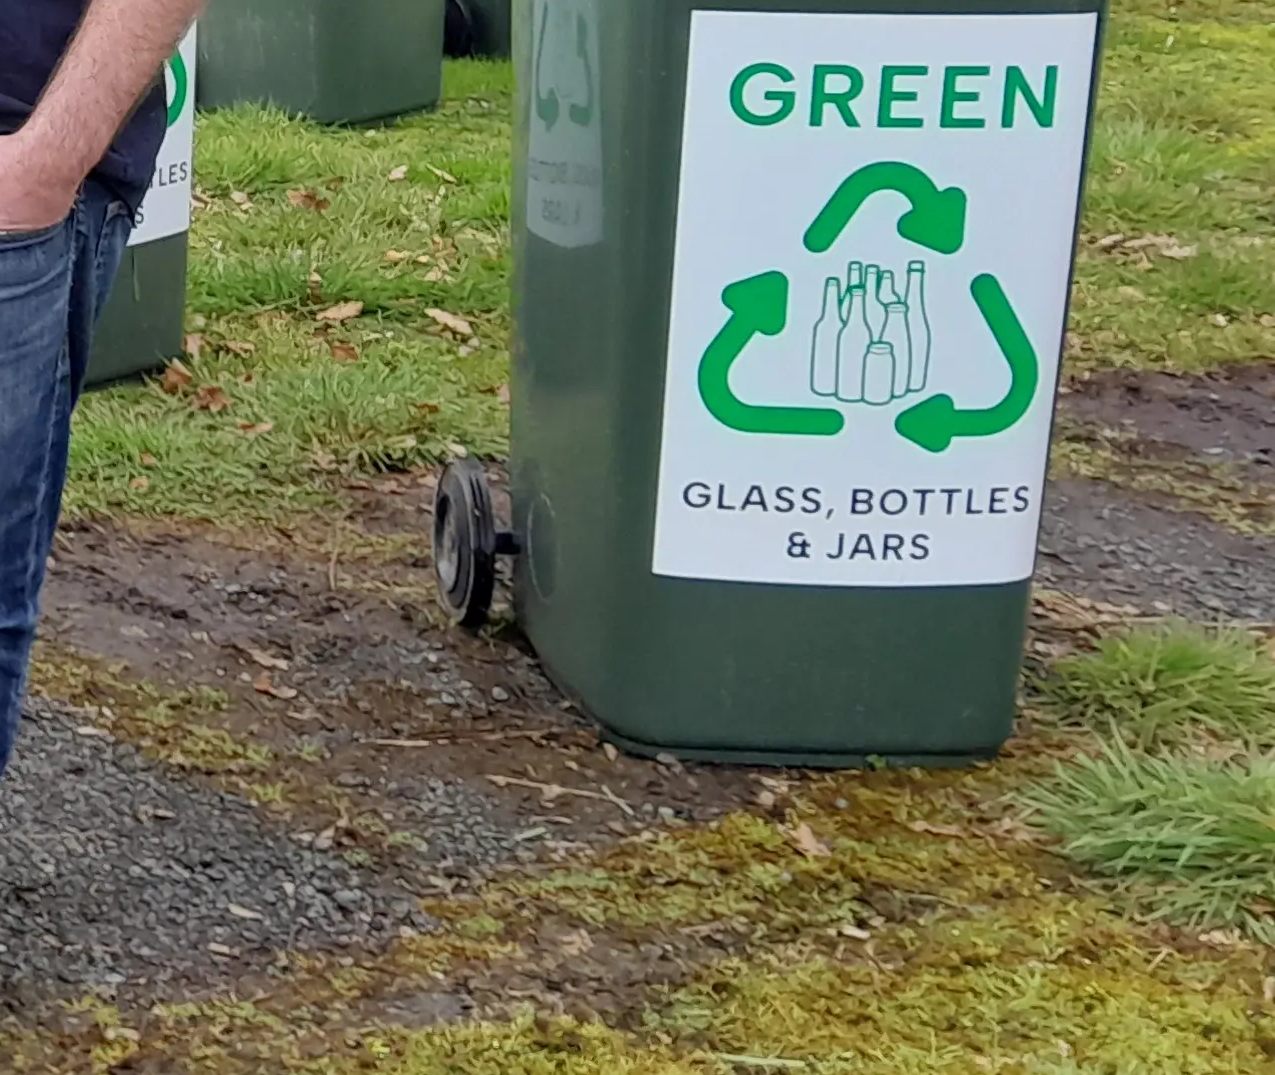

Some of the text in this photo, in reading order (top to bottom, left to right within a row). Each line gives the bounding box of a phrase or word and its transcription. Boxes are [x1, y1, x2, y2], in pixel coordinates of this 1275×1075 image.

[729, 63, 1058, 128] GREEN
[683, 482, 1028, 519] GLASS, BOTTLES
[787, 532, 929, 560] & JARS
